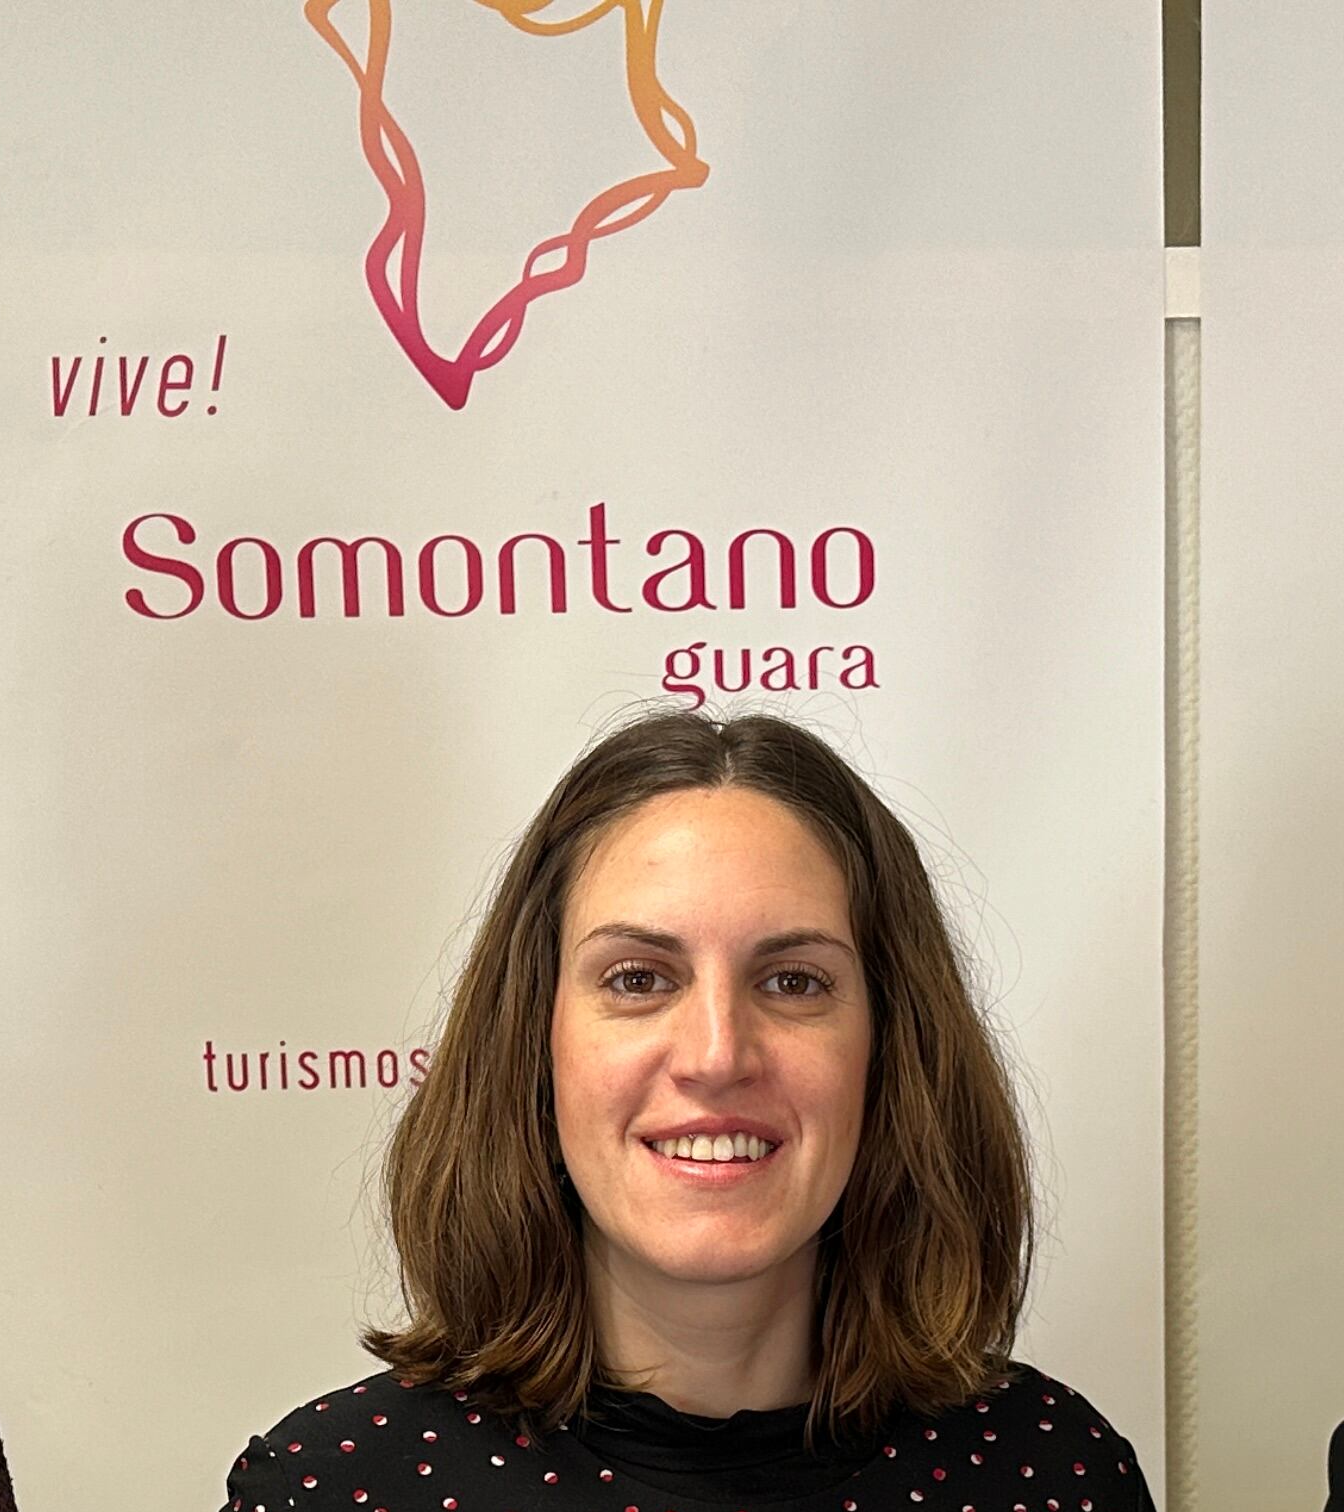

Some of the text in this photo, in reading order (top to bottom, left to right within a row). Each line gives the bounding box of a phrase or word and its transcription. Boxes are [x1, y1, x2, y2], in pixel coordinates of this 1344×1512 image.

[52, 334, 227, 418] vive!
[122, 502, 875, 621] Somontano
[662, 641, 881, 711] guara
